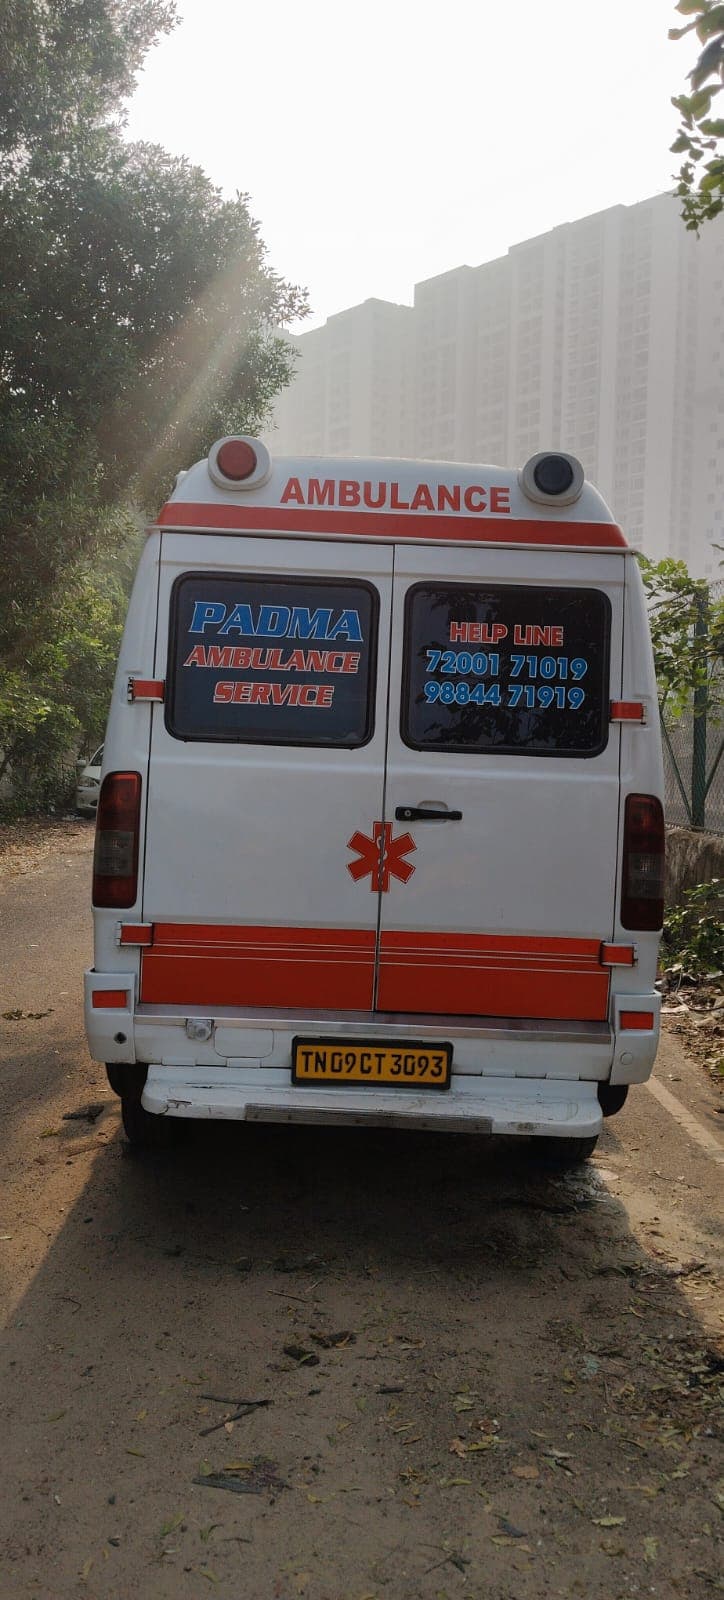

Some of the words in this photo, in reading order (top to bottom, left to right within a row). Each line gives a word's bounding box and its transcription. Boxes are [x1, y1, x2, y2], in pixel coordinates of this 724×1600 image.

[280, 477, 511, 513] AMBULANCE
[188, 601, 364, 642] PADMA
[450, 622, 508, 644] HELP
[514, 625, 564, 647] LINE
[183, 645, 361, 674] AMBULANCE
[426, 650, 500, 676] 72001
[510, 655, 588, 680] 71019
[213, 681, 335, 707] SERVICE
[424, 681, 501, 706] 98844
[508, 685, 585, 709] 71919
